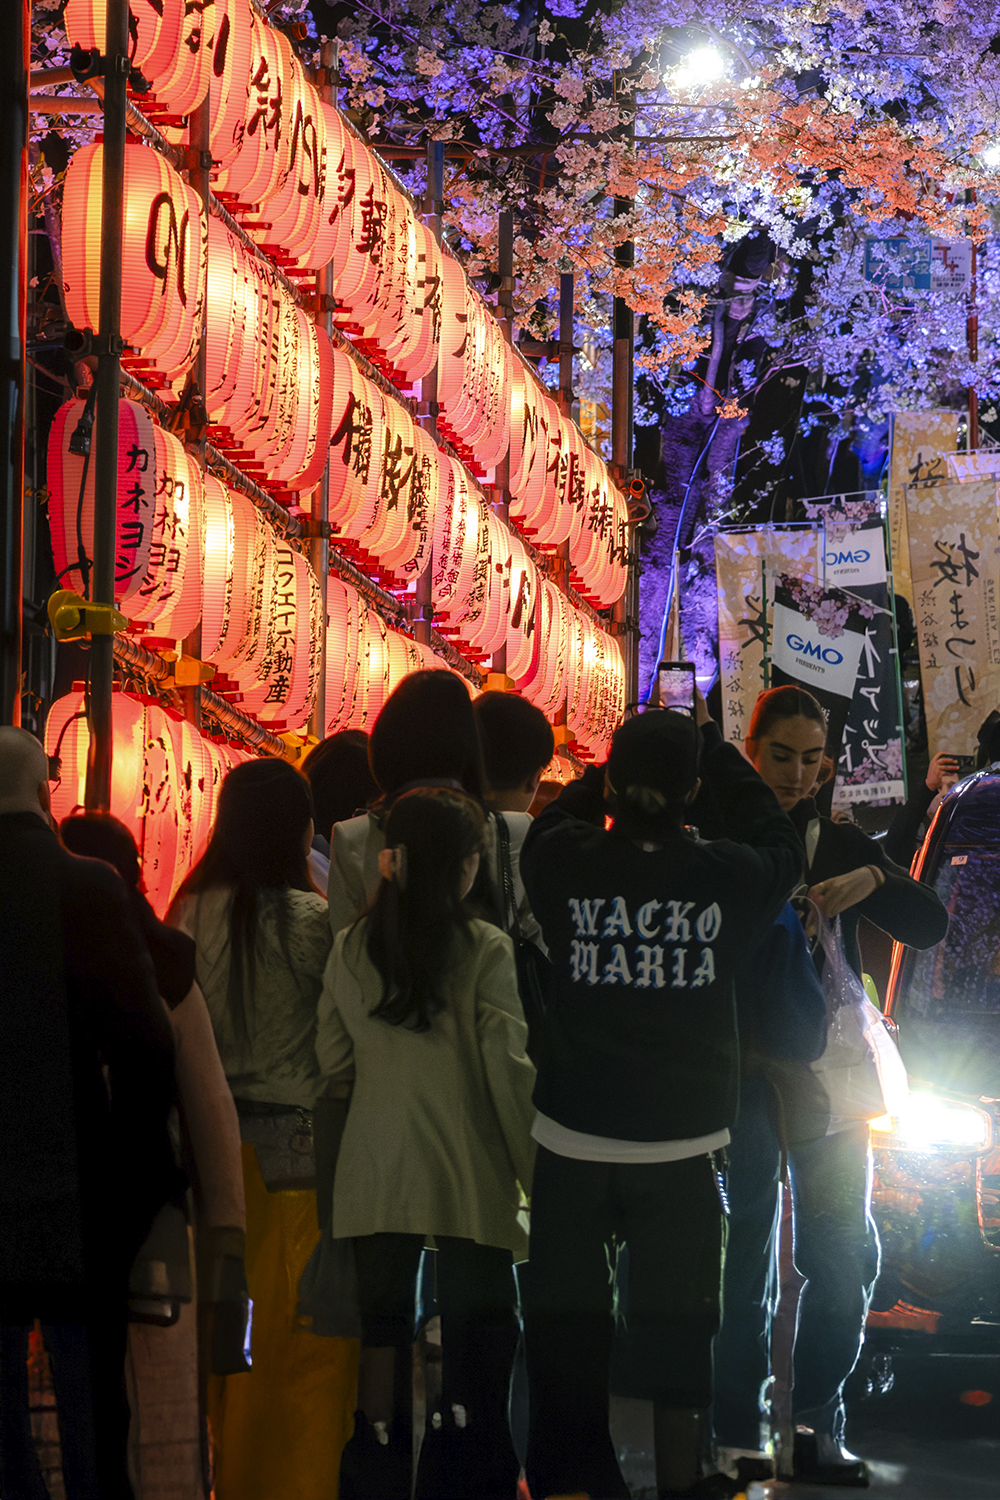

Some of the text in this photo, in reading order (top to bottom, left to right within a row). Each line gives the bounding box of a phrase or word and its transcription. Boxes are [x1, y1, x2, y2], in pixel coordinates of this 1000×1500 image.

[115, 444, 149, 581] カネヨシ
[786, 634, 844, 665] GMO
[568, 896, 722, 943] WACKO
[569, 939, 716, 989] MARIA
